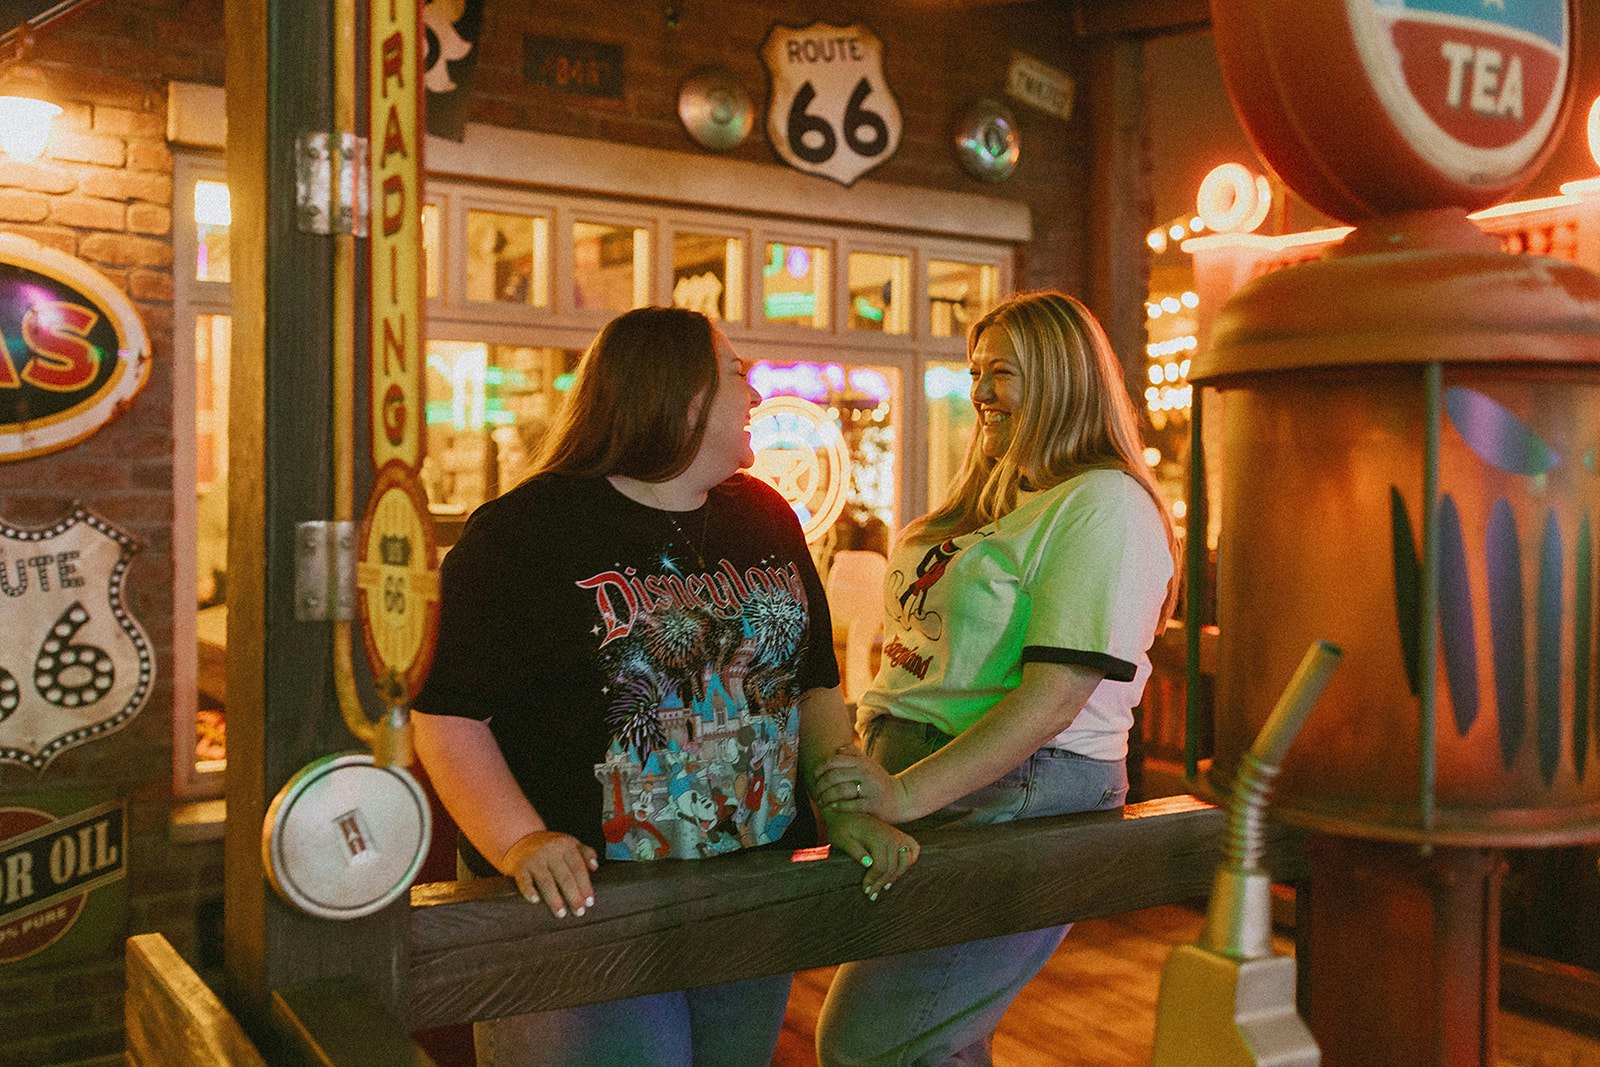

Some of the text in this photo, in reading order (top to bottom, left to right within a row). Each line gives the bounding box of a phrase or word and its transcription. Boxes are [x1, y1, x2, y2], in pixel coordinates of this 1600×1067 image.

[786, 37, 864, 63] ROUTE
[1441, 41, 1523, 121] TEA
[787, 76, 890, 165] 66
[0, 601, 115, 722] 6
[0, 820, 118, 904] R OIL
